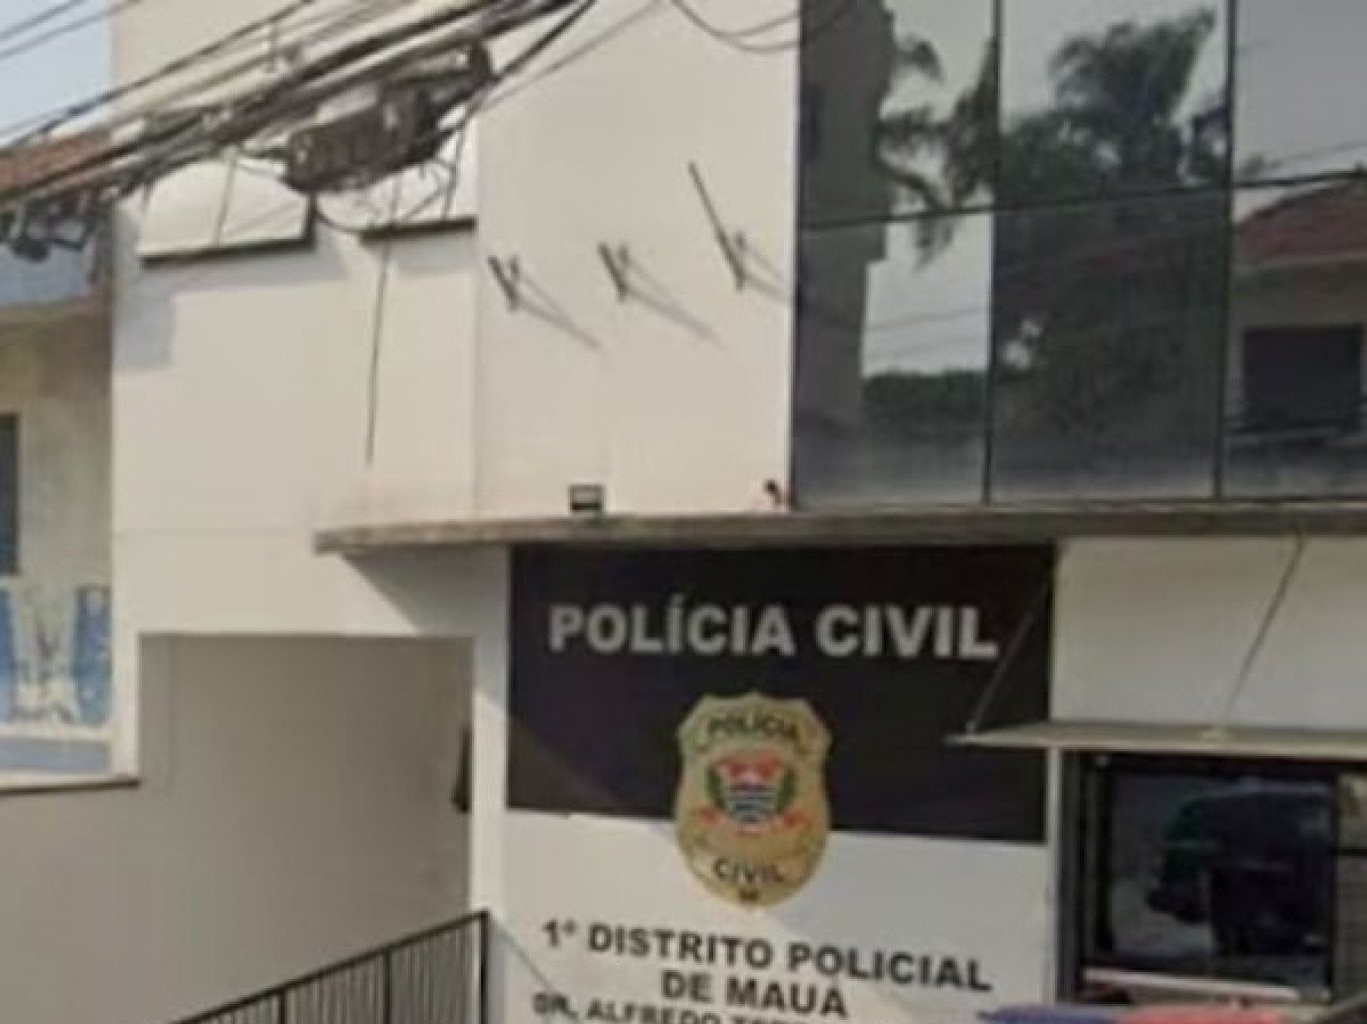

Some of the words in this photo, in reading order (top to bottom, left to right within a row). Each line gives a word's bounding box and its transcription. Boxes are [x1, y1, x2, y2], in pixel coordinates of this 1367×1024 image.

[548, 594, 796, 656] POLÍCIA
[816, 606, 998, 658] CIVIL
[712, 857, 787, 884] CIVIL
[588, 923, 773, 969] DISTRITO
[787, 942, 993, 992] POLICIAL
[661, 970, 714, 1004] DE
